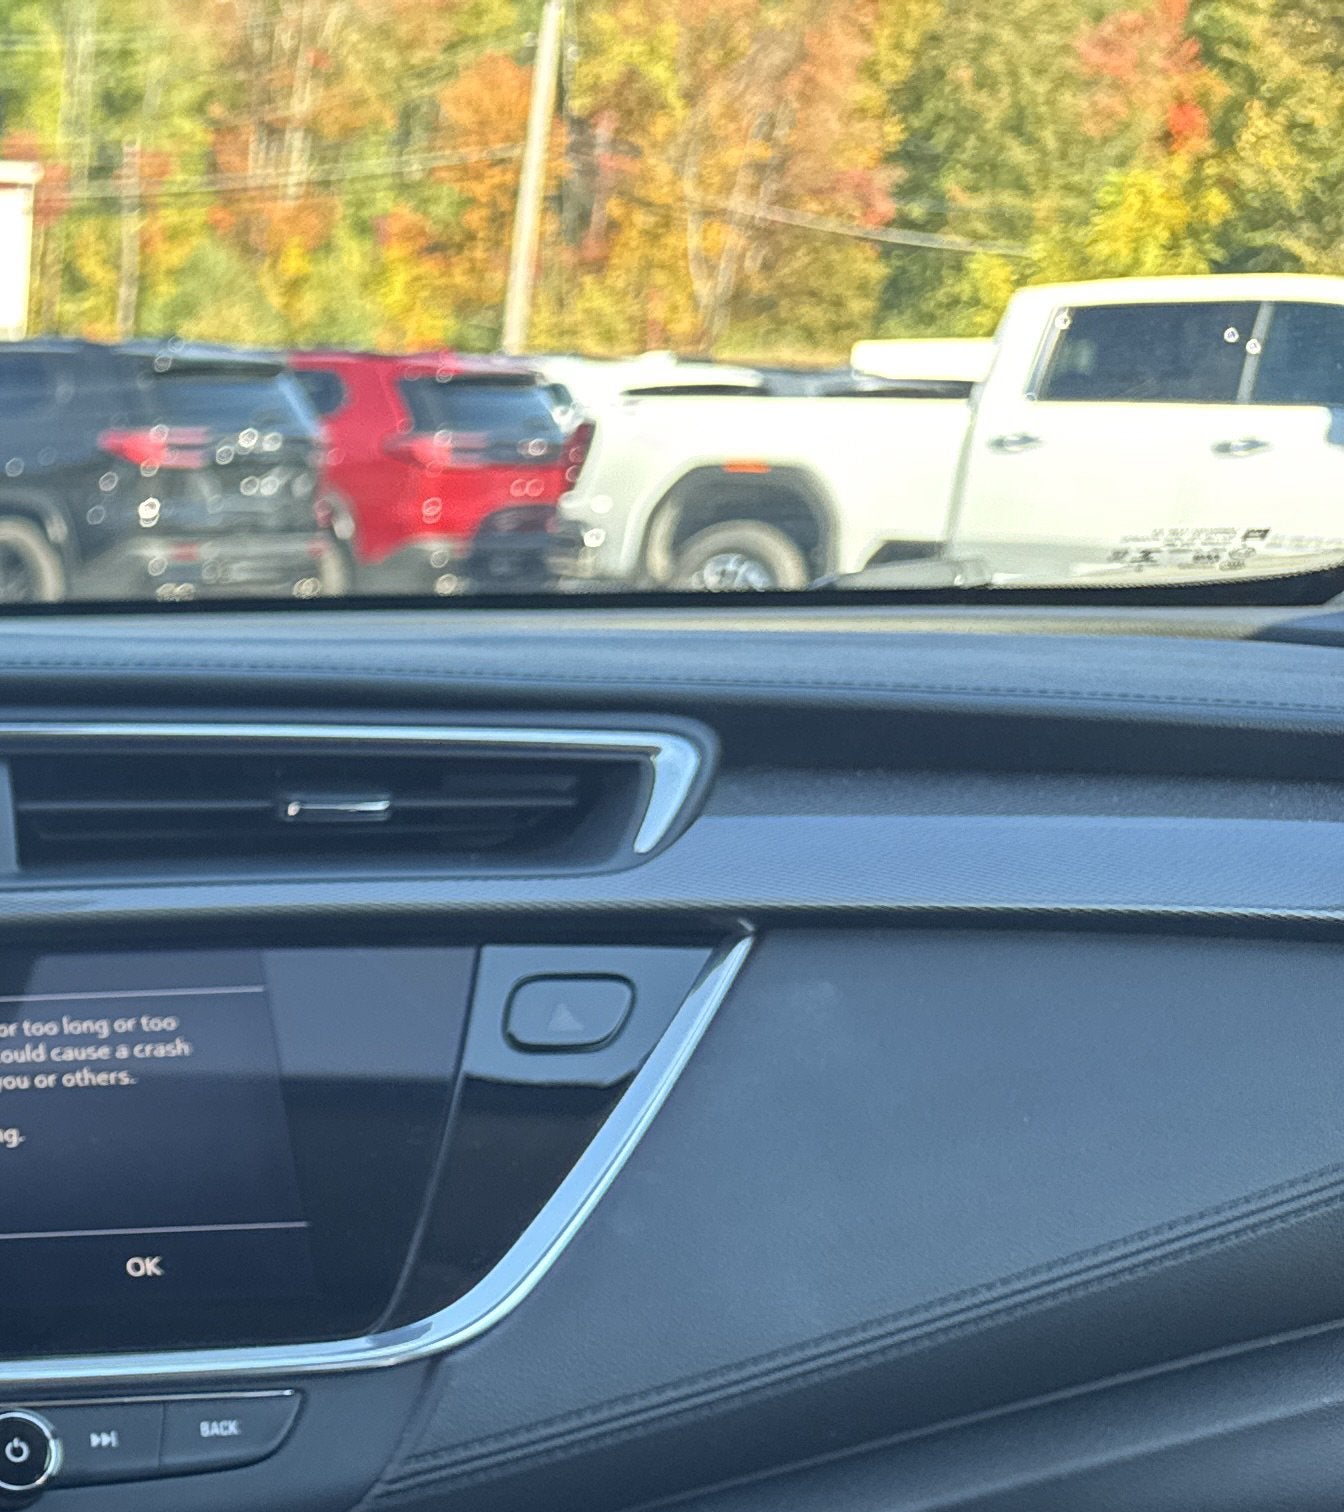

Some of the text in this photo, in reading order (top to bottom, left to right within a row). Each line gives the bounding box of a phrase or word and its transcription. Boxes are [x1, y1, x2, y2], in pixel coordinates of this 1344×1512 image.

[22, 1019, 59, 1037] too
[62, 1016, 109, 1039] long
[114, 1016, 138, 1032] or
[141, 1014, 180, 1031] too
[50, 1044, 111, 1062] cause
[115, 1044, 129, 1060] a
[133, 1036, 192, 1057] crash
[34, 1072, 57, 1089] or
[61, 1066, 139, 1088] others.
[126, 1256, 163, 1278] OK
[200, 1420, 240, 1438] BACK
